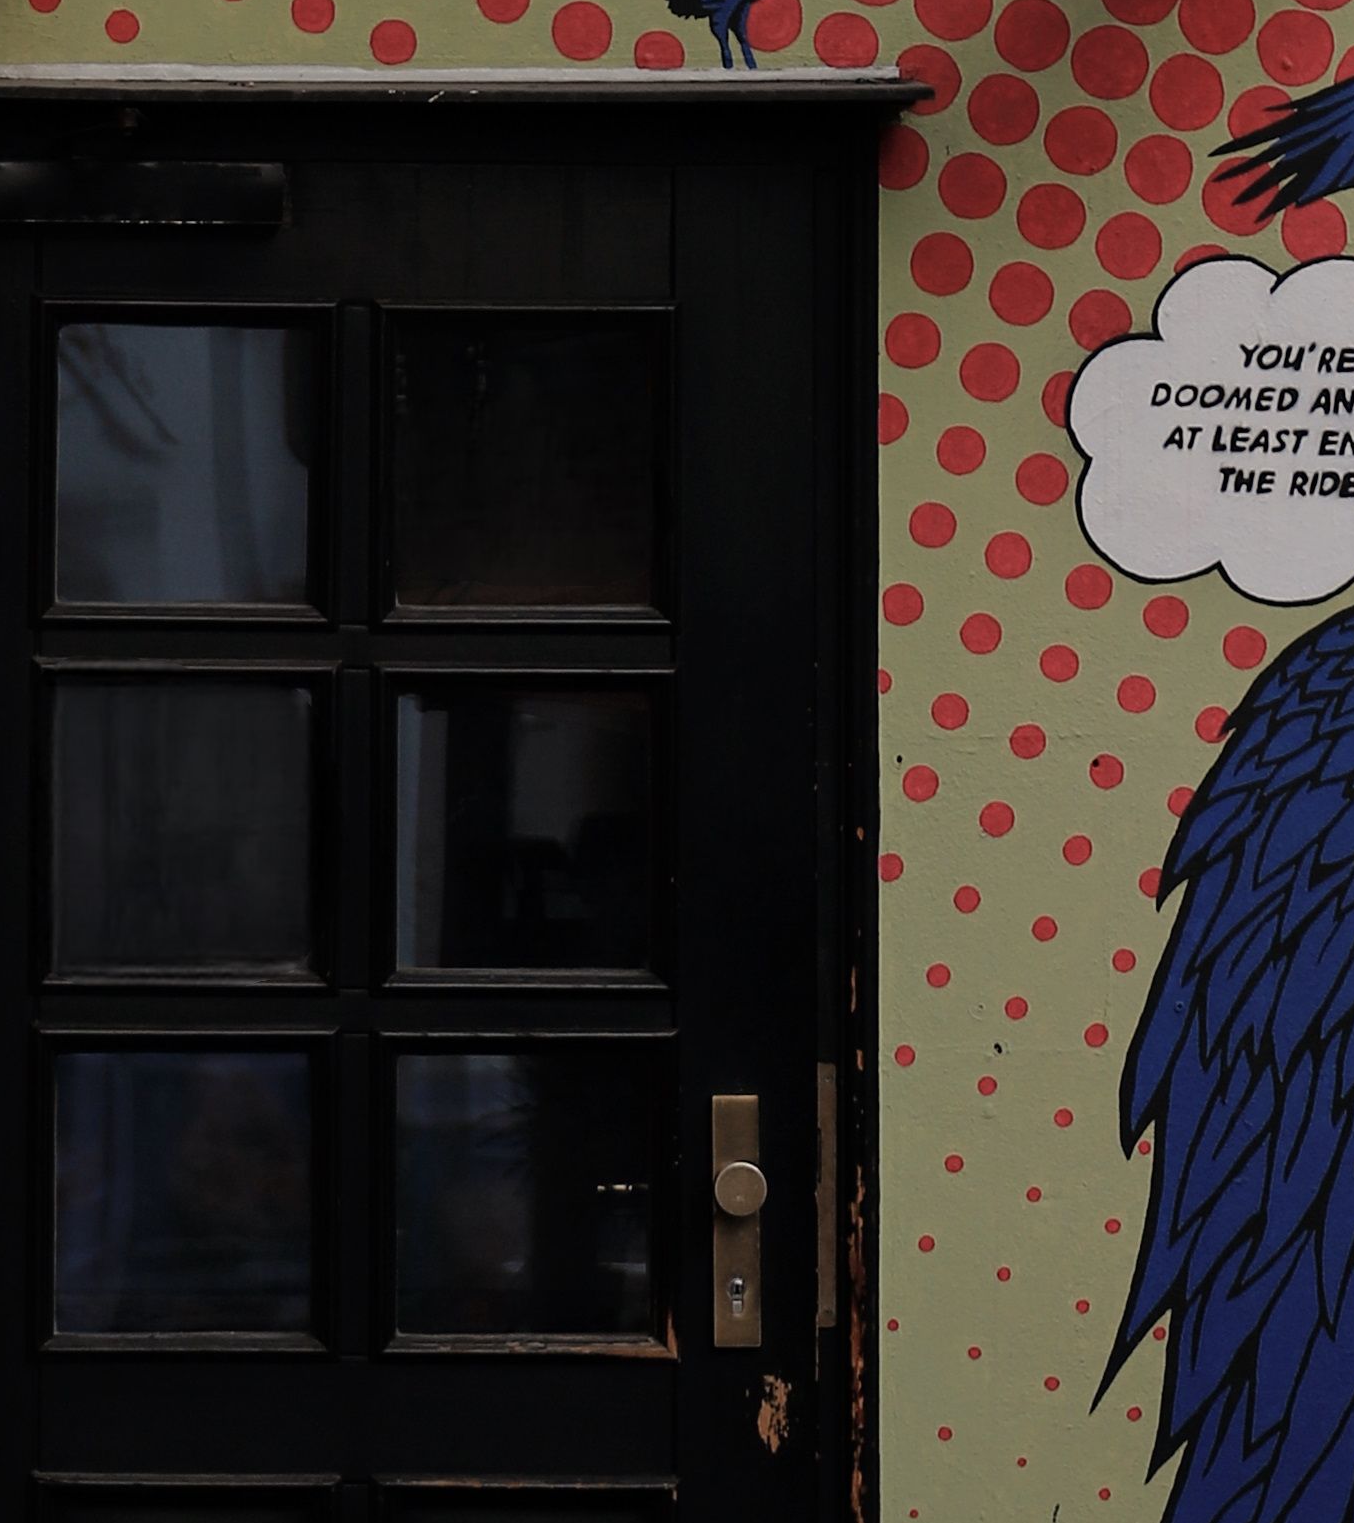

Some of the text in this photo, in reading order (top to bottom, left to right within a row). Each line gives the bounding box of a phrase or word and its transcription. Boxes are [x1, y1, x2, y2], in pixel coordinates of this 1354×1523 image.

[1149, 382, 1301, 412] DOOMED
[1163, 425, 1204, 451] AT
[1211, 425, 1310, 454] LEAST
[1219, 466, 1276, 495] THE
